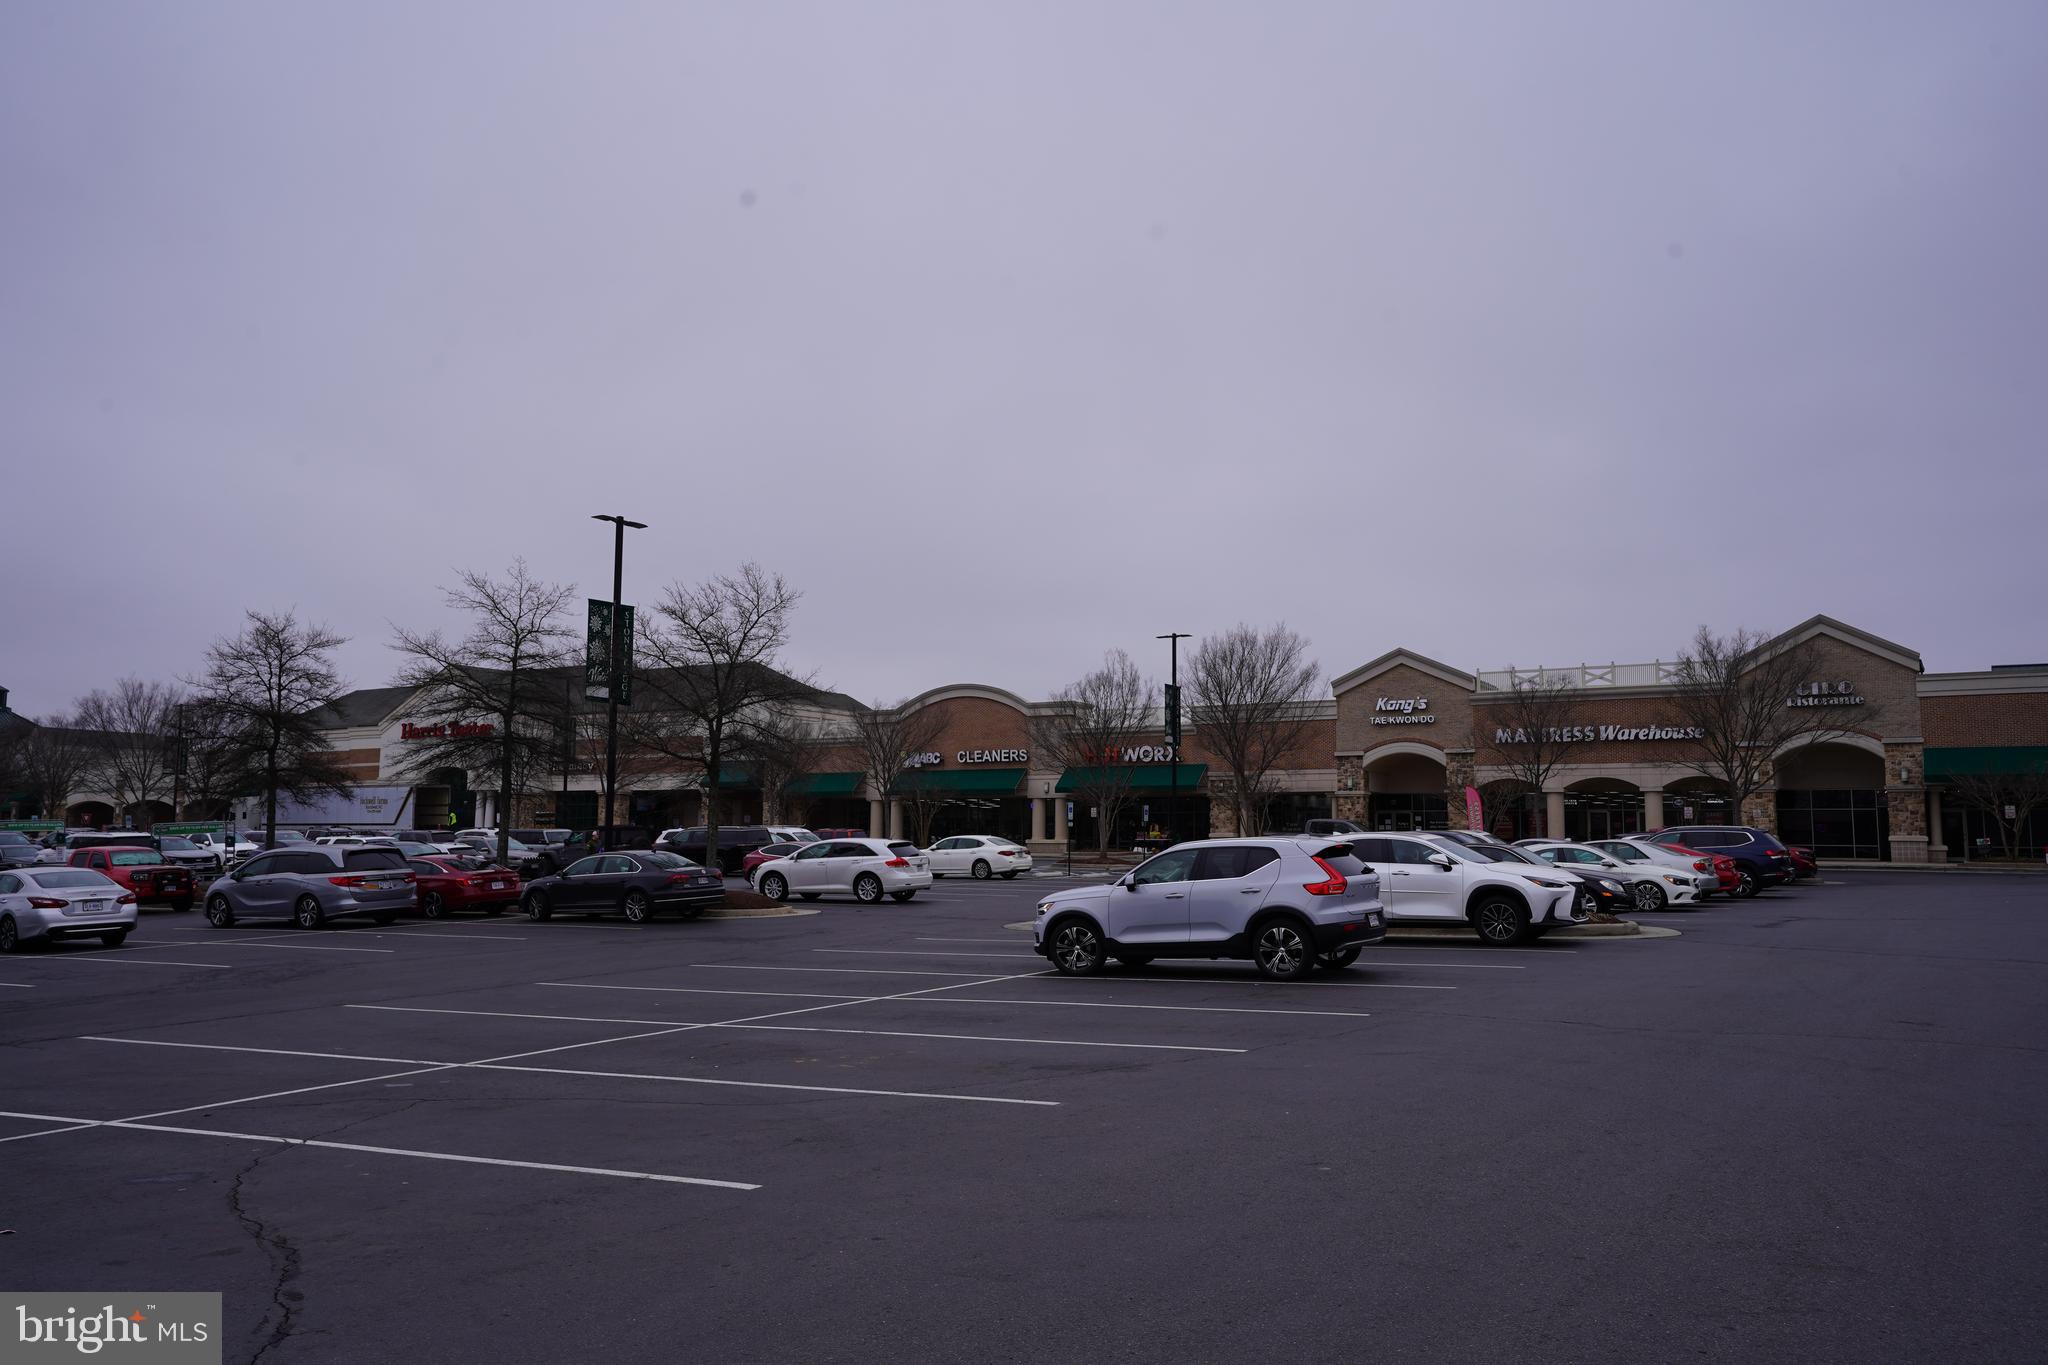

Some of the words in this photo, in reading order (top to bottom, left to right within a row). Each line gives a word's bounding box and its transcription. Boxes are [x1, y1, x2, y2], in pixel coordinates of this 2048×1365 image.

[1375, 697, 1428, 714] Kang's
[1786, 696, 1865, 707] Ristorante
[1369, 716, 1388, 725] TAE
[1389, 715, 1419, 724] KWON
[1420, 715, 1435, 724] DO
[401, 722, 446, 740] Harris
[1599, 723, 1705, 741] Warehouse
[919, 752, 941, 765] ABC
[957, 749, 1028, 763] CLEANERS
[1083, 745, 1183, 763] TWORX
